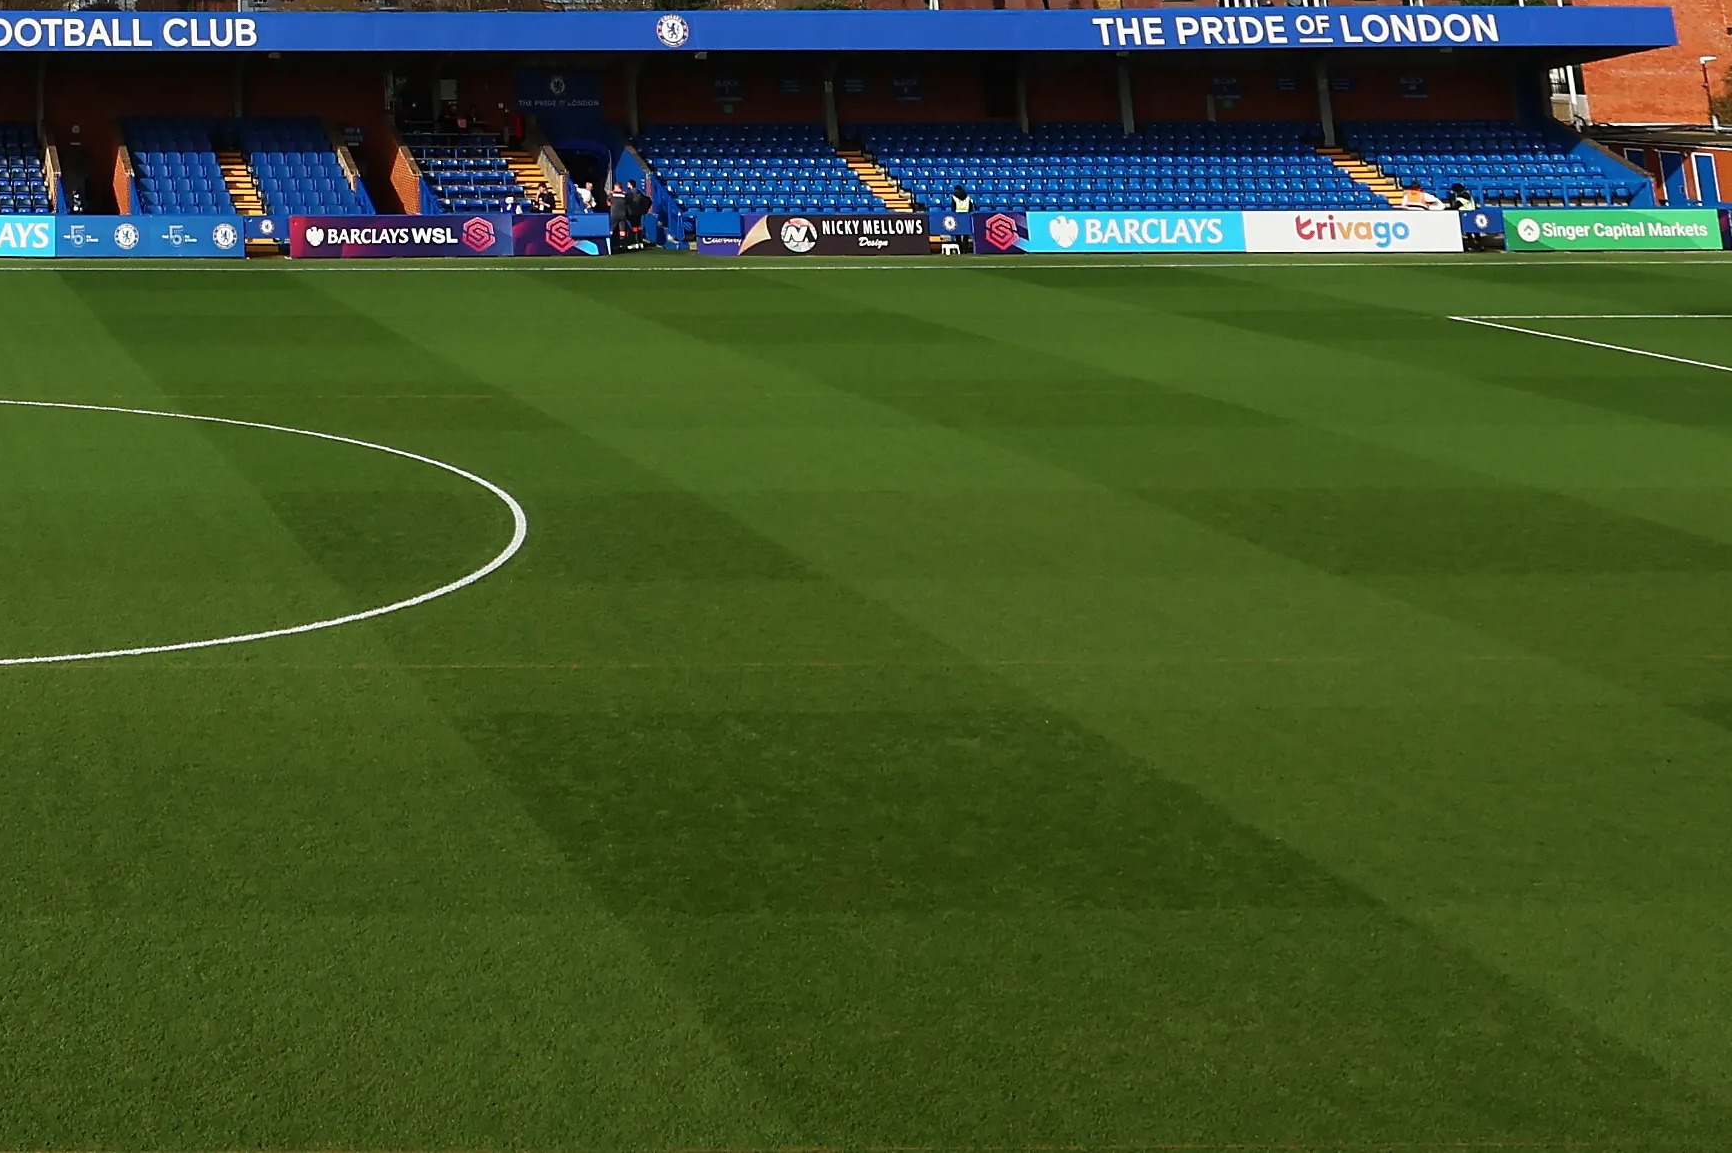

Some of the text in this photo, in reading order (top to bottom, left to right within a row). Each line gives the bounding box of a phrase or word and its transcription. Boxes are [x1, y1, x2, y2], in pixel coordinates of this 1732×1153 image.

[163, 17, 257, 48] CLUB
[1092, 14, 1499, 46] THE PRIDE OF LONDON
[328, 228, 458, 244] BARCLAYS WSL
[822, 219, 924, 235] NICKY MELLOWS
[1085, 218, 1223, 244] BARCLAYS
[1295, 214, 1410, 248] trivago
[1542, 222, 1590, 240] Singer
[1593, 222, 1645, 240] Capital
[1648, 223, 1708, 237] Markets
[858, 236, 889, 249] Design
